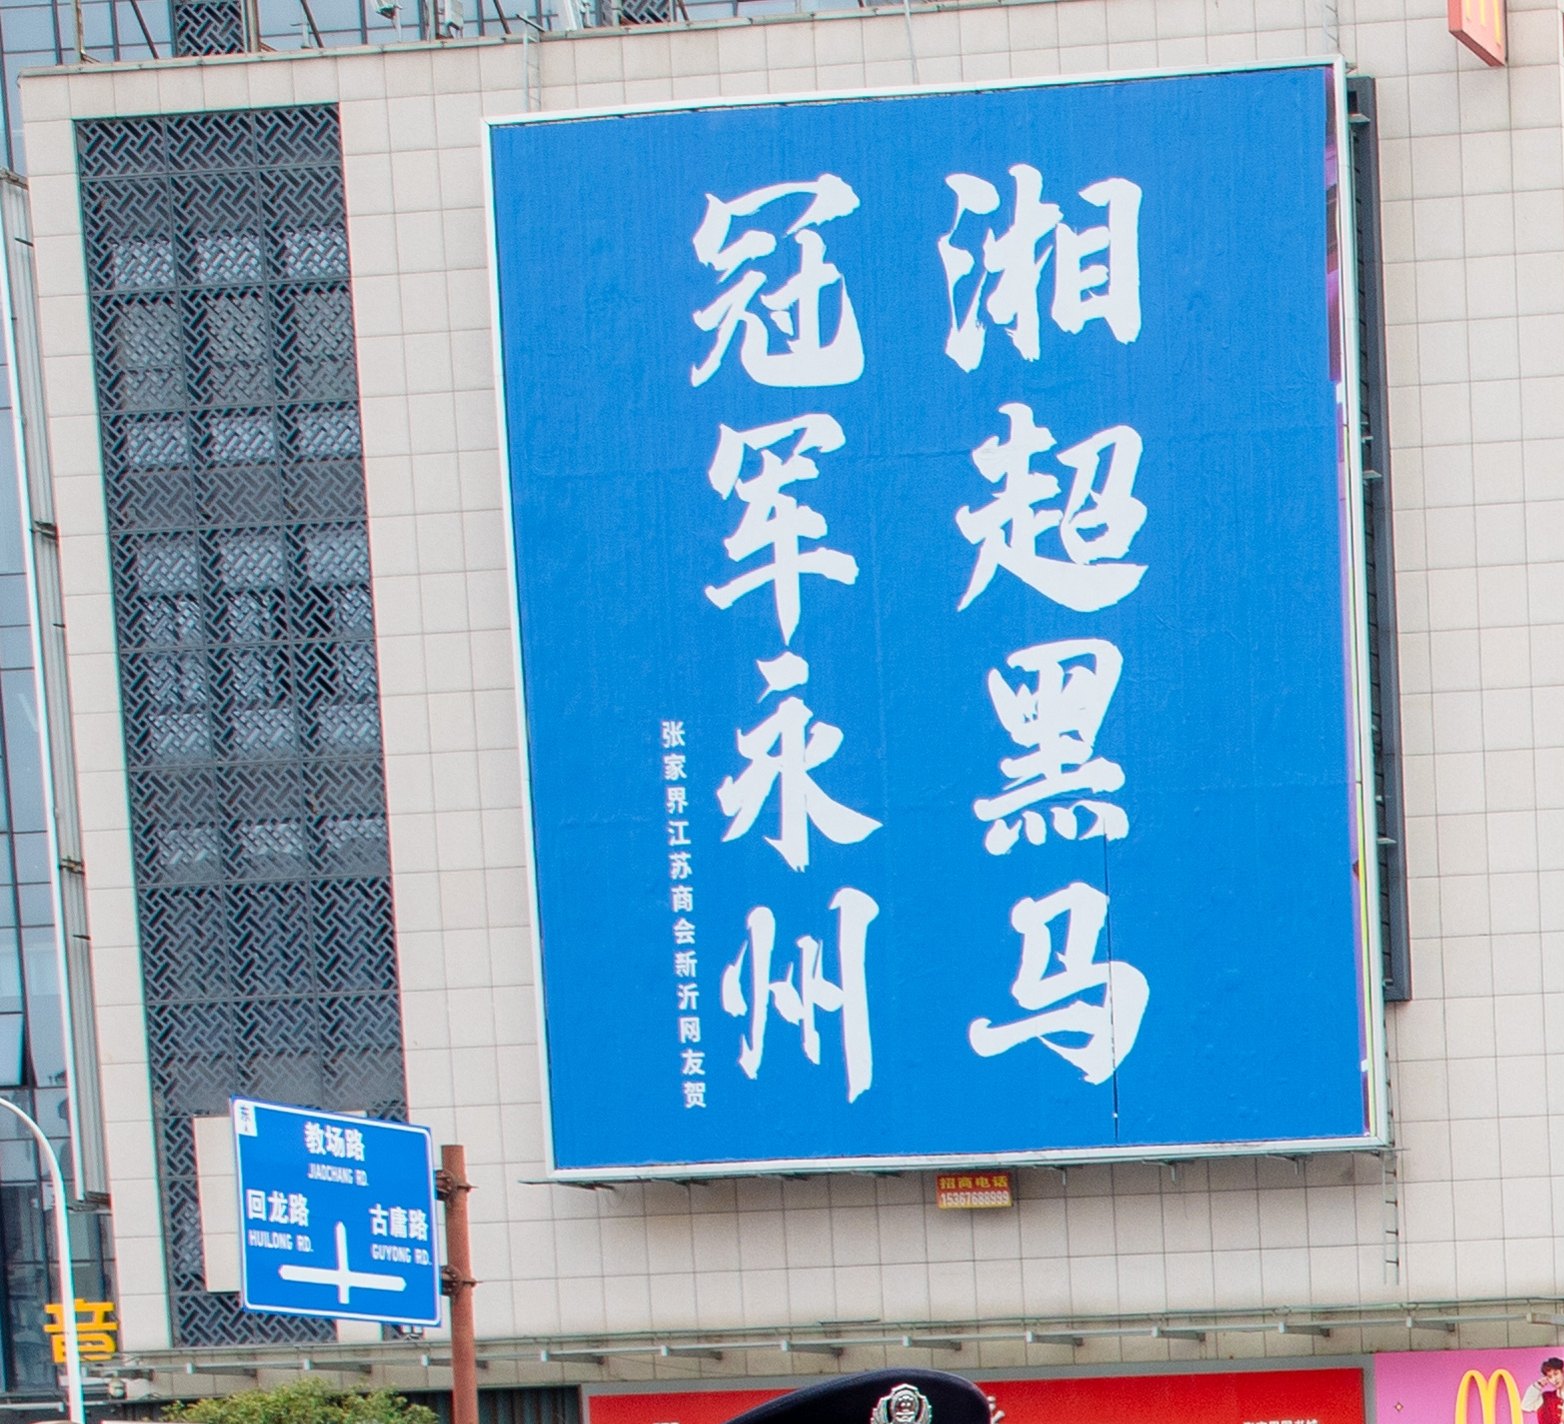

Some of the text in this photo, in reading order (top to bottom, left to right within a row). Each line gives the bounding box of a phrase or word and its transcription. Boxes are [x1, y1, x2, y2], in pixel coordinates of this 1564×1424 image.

[689, 173, 882, 1104] 冠军永州
[941, 164, 1149, 1087] 湘超黑马
[662, 721, 706, 1108] 张家界江苏商会新沂网友贺
[304, 1122, 366, 1161] 教场路
[307, 1163, 354, 1184] JIAOCHANG
[246, 1189, 309, 1227] 回龙路
[368, 1203, 428, 1241] 古庸路
[248, 1229, 293, 1250] HUILONG
[371, 1244, 411, 1263] GUYONG
